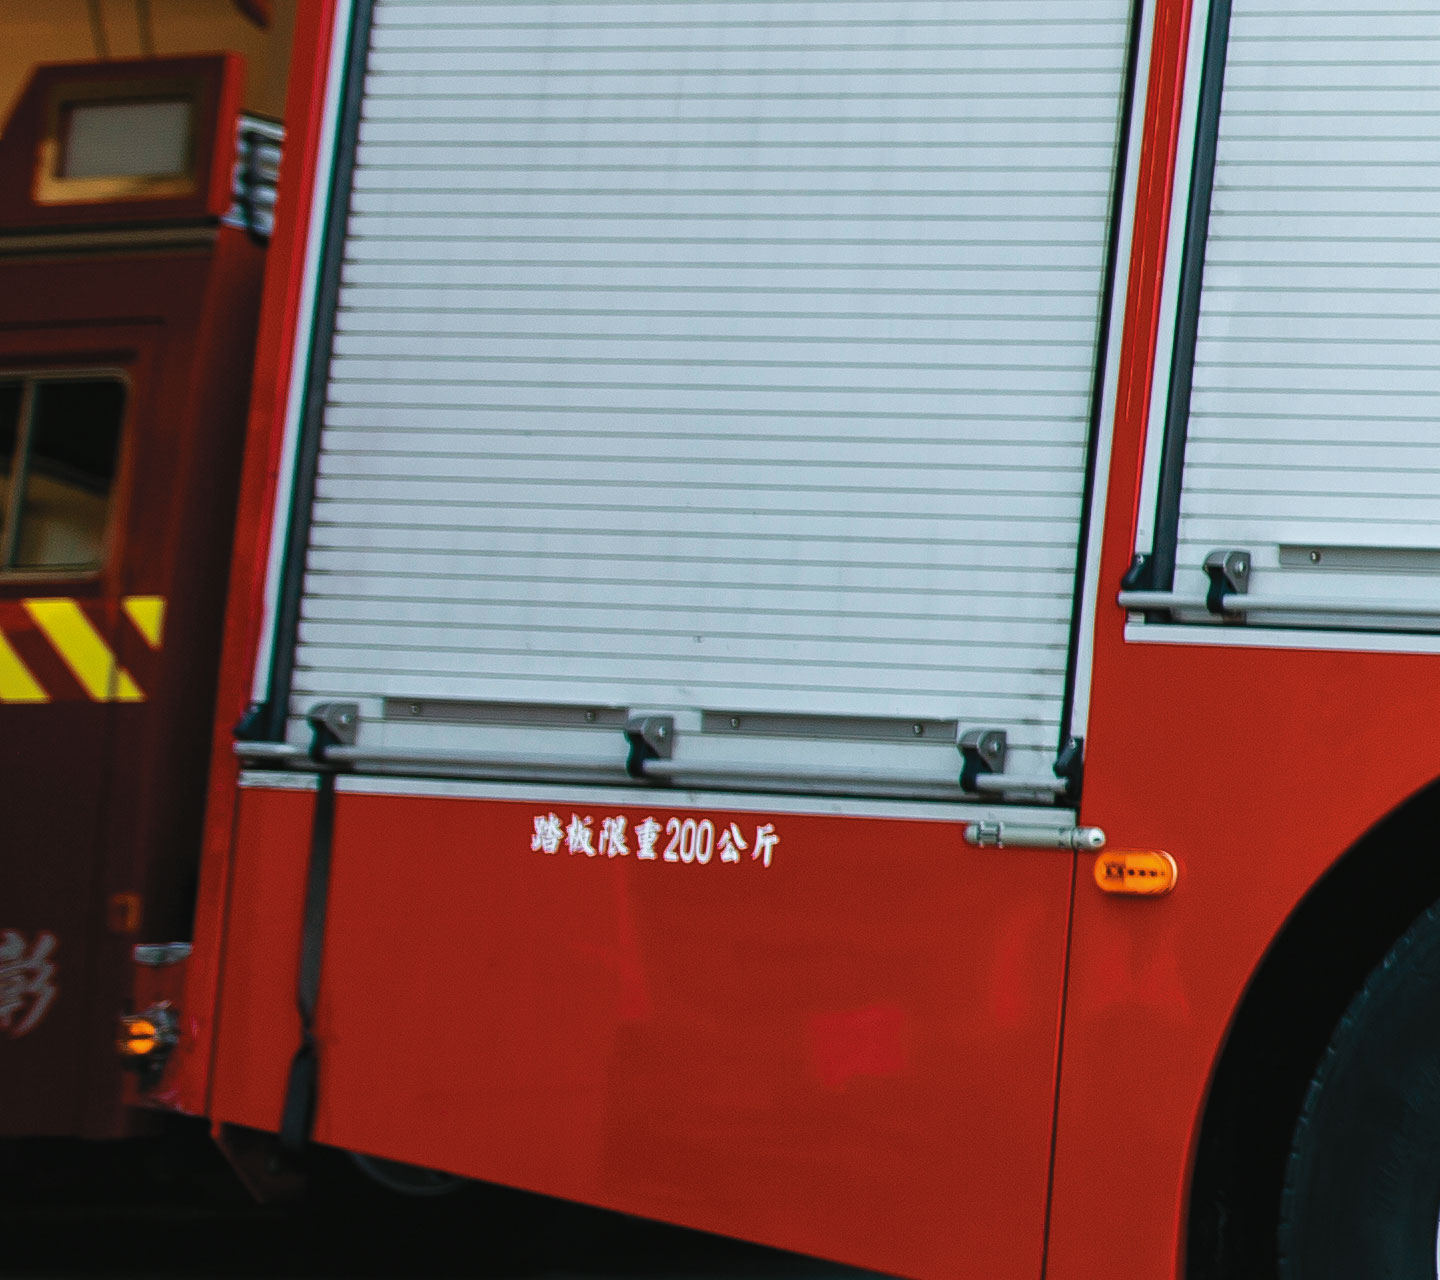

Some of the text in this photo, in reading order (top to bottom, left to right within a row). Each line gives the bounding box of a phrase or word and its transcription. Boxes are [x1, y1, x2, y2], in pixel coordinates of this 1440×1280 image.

[531, 812, 780, 867] 踏板限重200公斤
